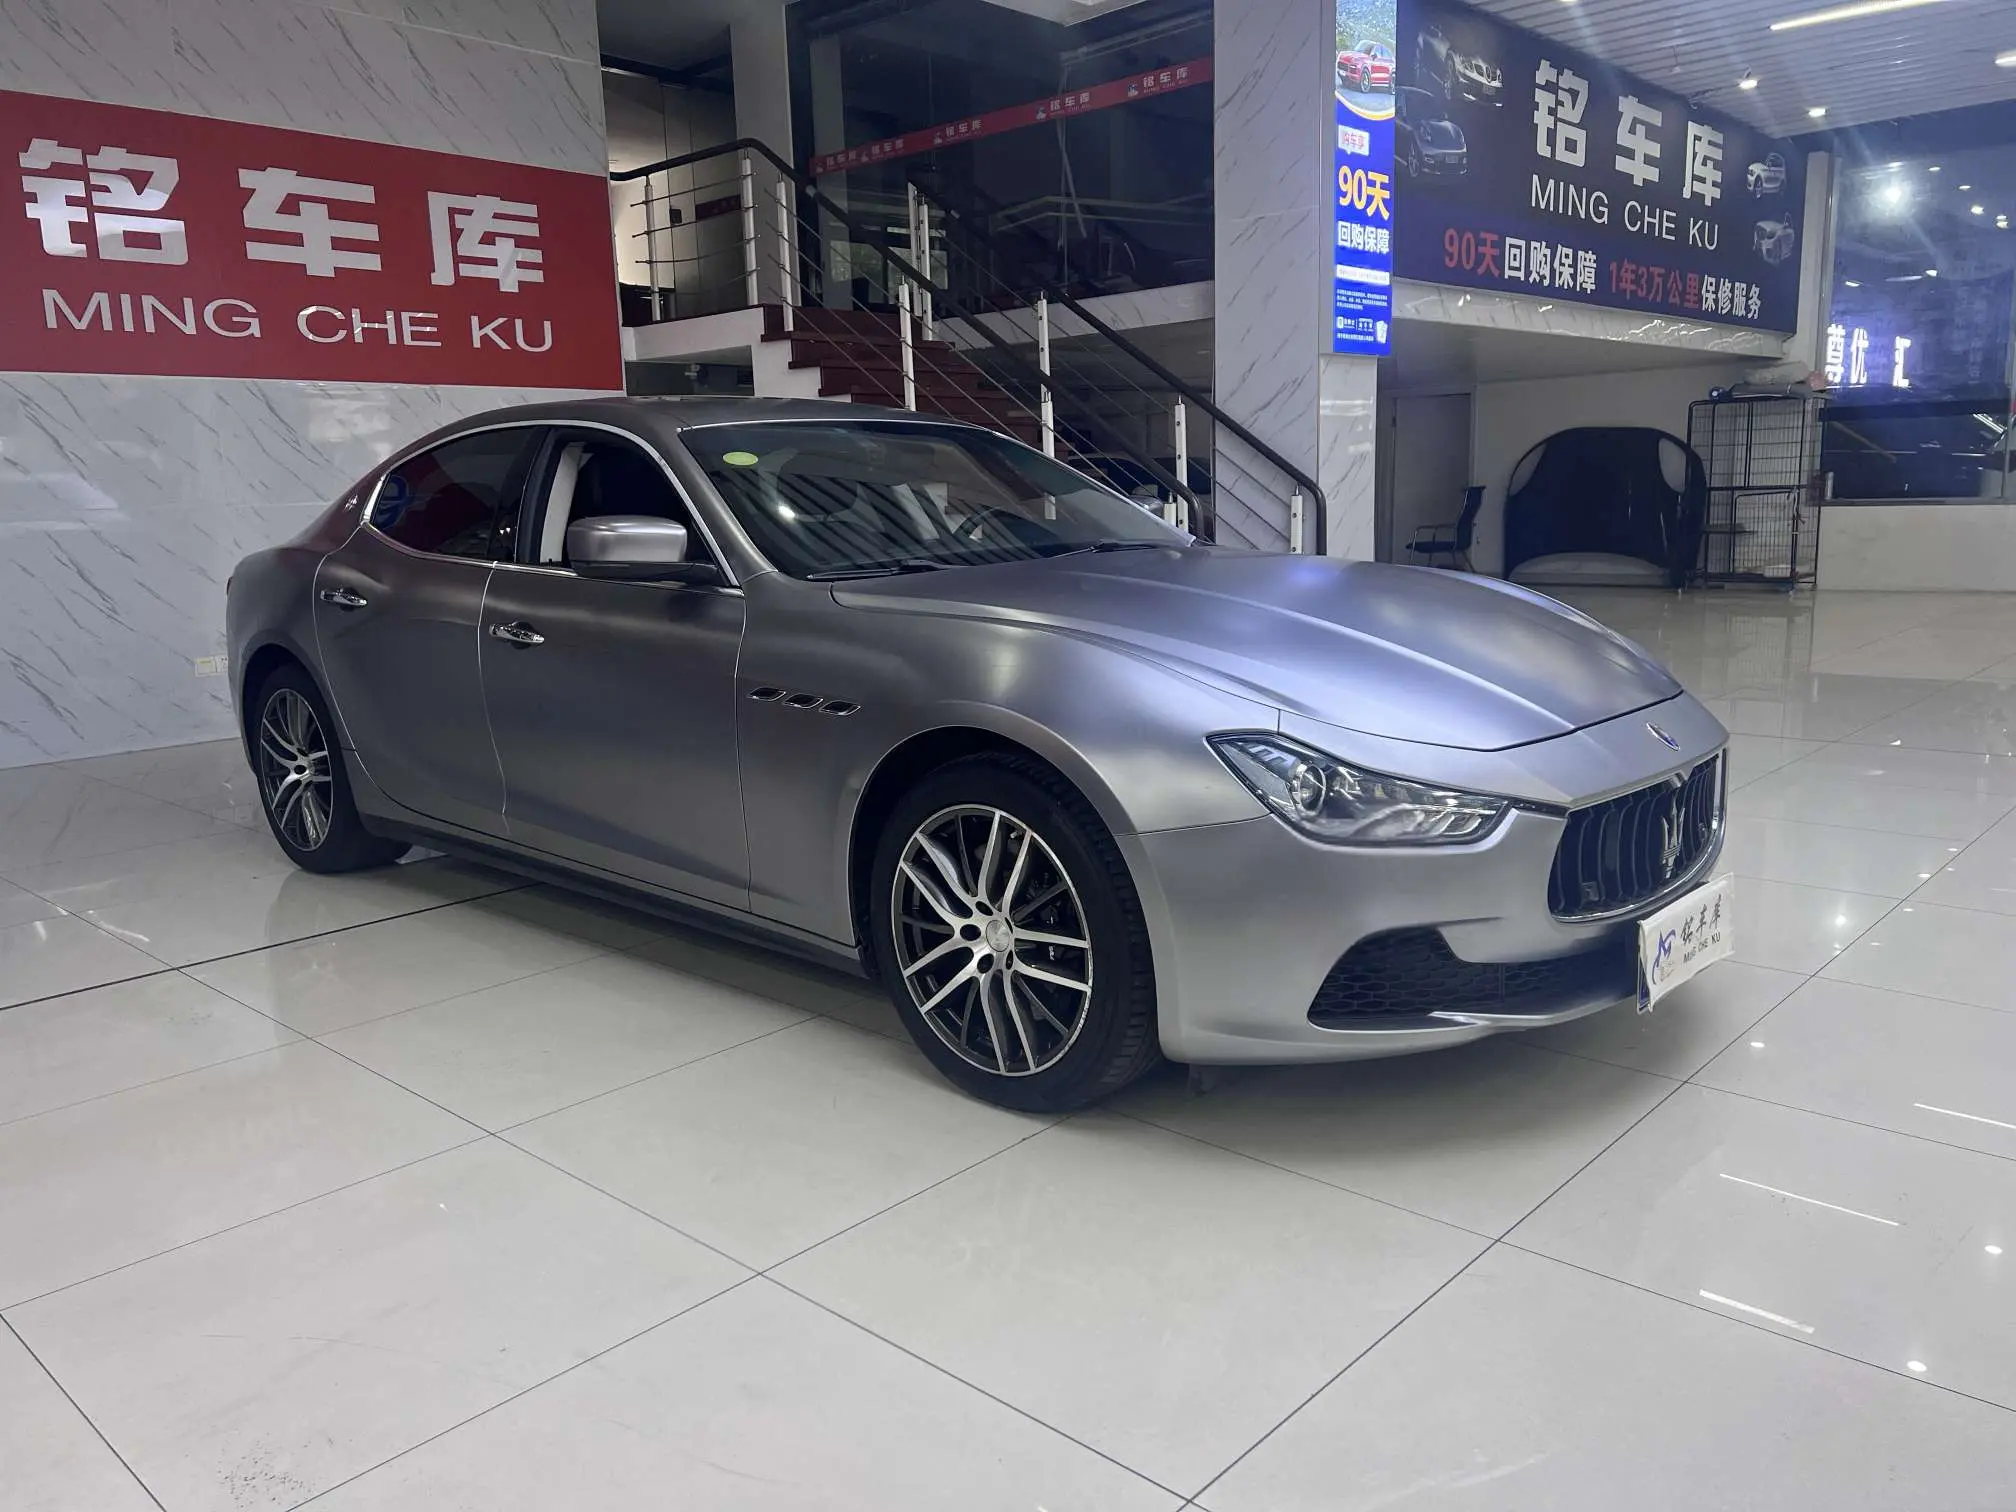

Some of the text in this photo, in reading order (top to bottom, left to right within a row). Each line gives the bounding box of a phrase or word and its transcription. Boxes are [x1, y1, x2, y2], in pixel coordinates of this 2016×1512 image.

[1534, 59, 1725, 206] 铭车库
[19, 137, 545, 293] 铭车库
[1338, 165, 1390, 221] 90天
[1531, 174, 1719, 251] MING CHE KU
[1337, 220, 1390, 255] 回购保障
[42, 288, 553, 353] MING CHE KU
